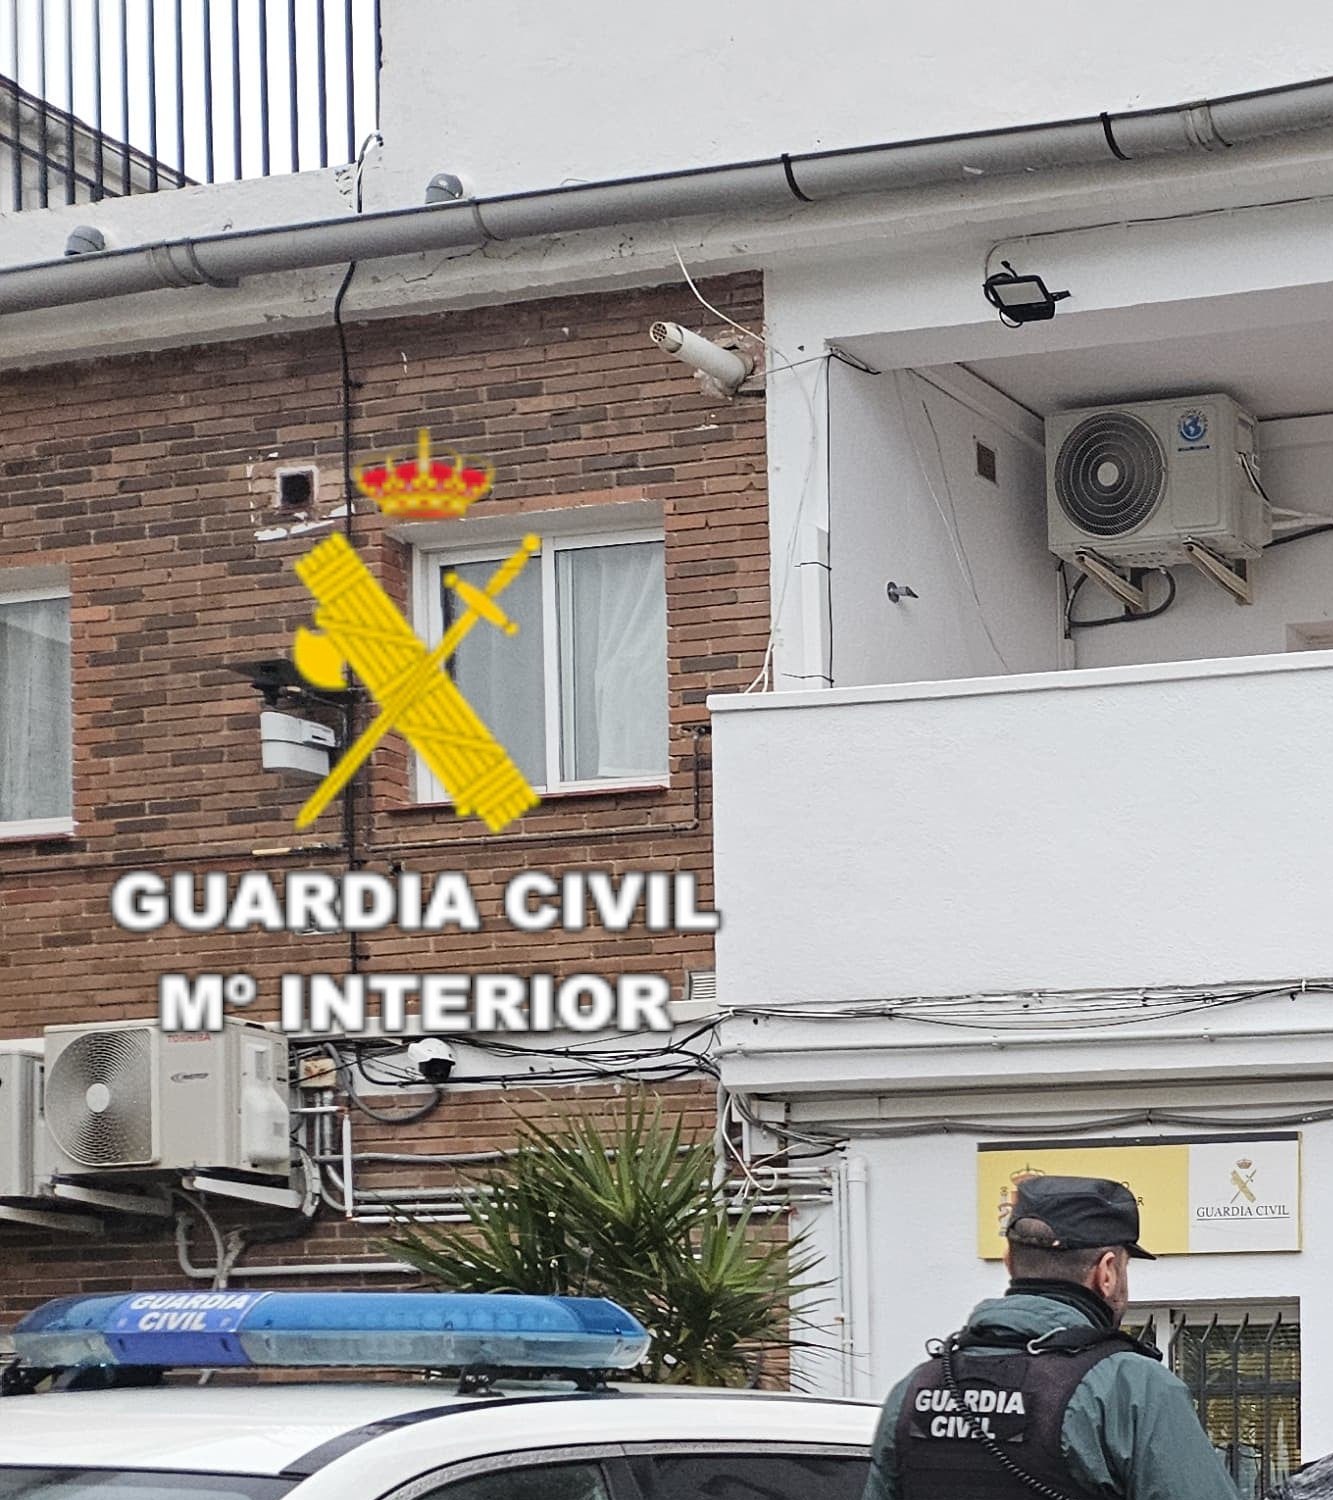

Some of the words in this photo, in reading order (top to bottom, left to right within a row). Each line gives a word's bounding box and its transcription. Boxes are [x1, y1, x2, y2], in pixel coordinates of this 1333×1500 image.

[1196, 1205, 1252, 1218] GUARDIA
[1256, 1204, 1290, 1216] CIVIL
[130, 1294, 249, 1310] GUARDIA
[139, 1311, 207, 1331] CIVIL
